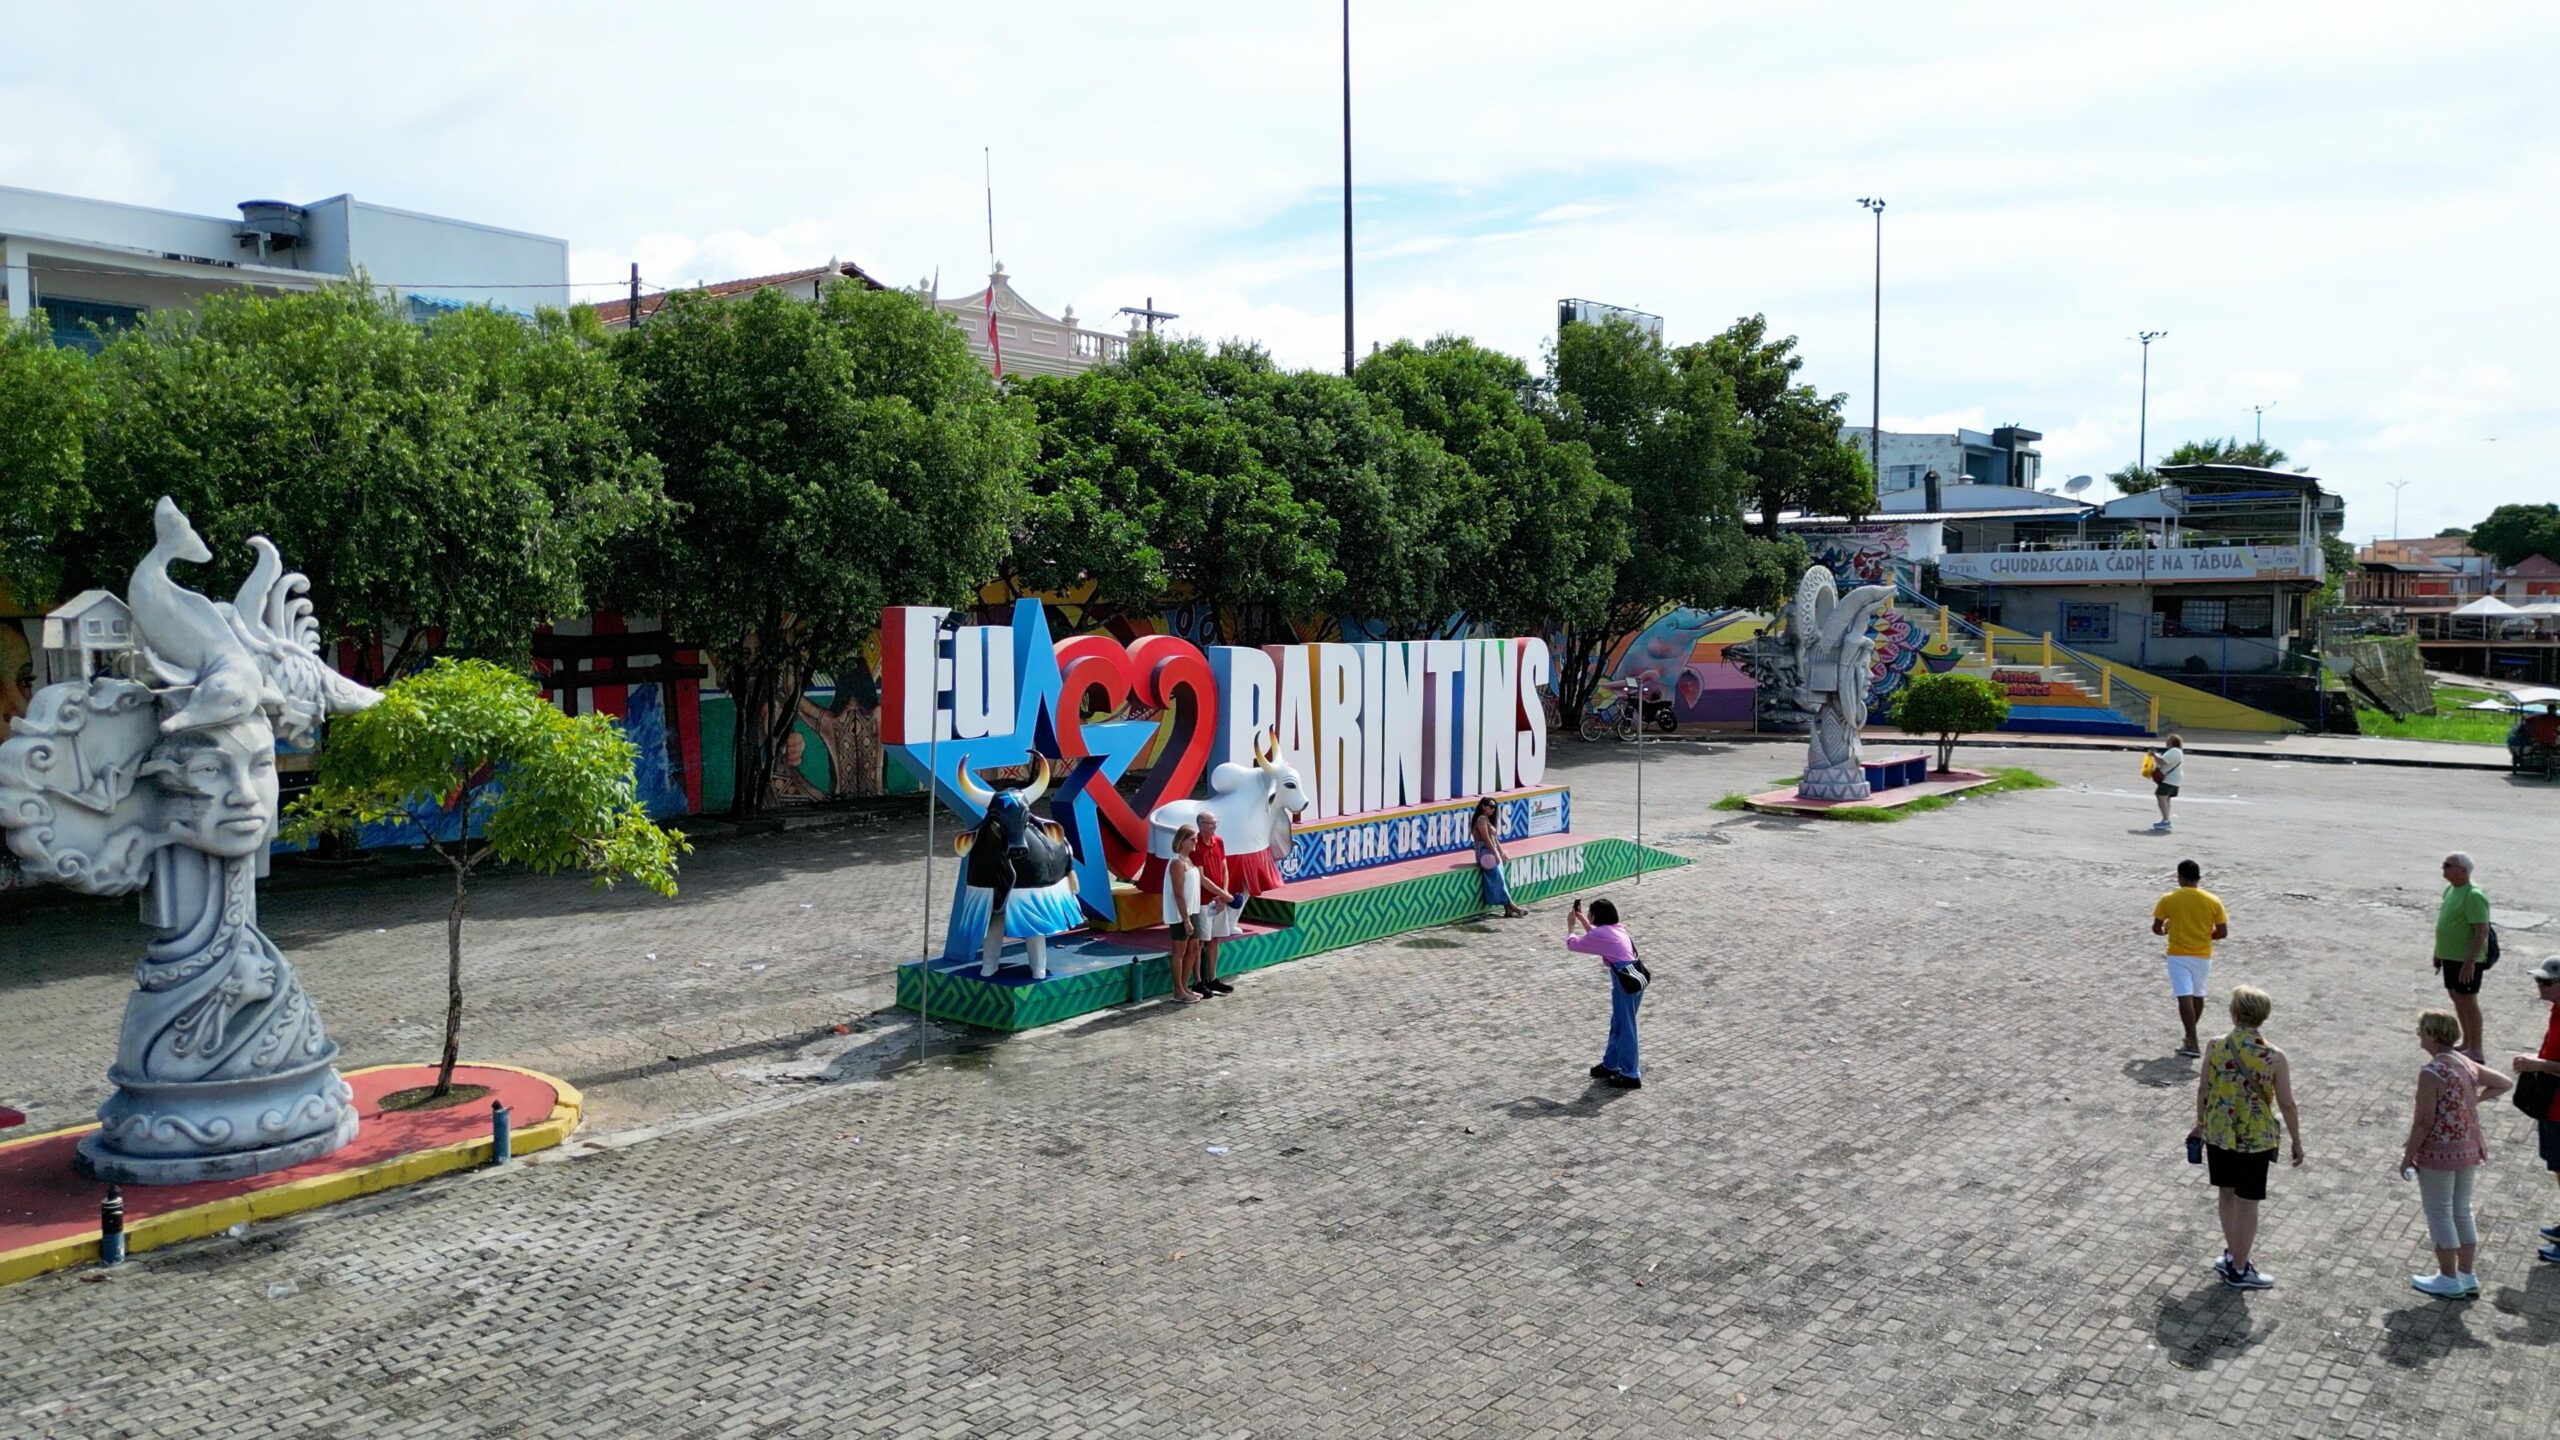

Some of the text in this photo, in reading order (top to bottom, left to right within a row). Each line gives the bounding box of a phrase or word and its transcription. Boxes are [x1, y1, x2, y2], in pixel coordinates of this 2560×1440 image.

[2162, 555, 2184, 571] NA
[2191, 550, 2243, 570] TÁBUA
[1230, 637, 1550, 823] PARINTINS
[1322, 823, 1390, 868] TERRA
[1398, 818, 1422, 854] DE
[1426, 803, 1512, 848] ARTIS
[1510, 847, 1584, 889] AMAZONAS
